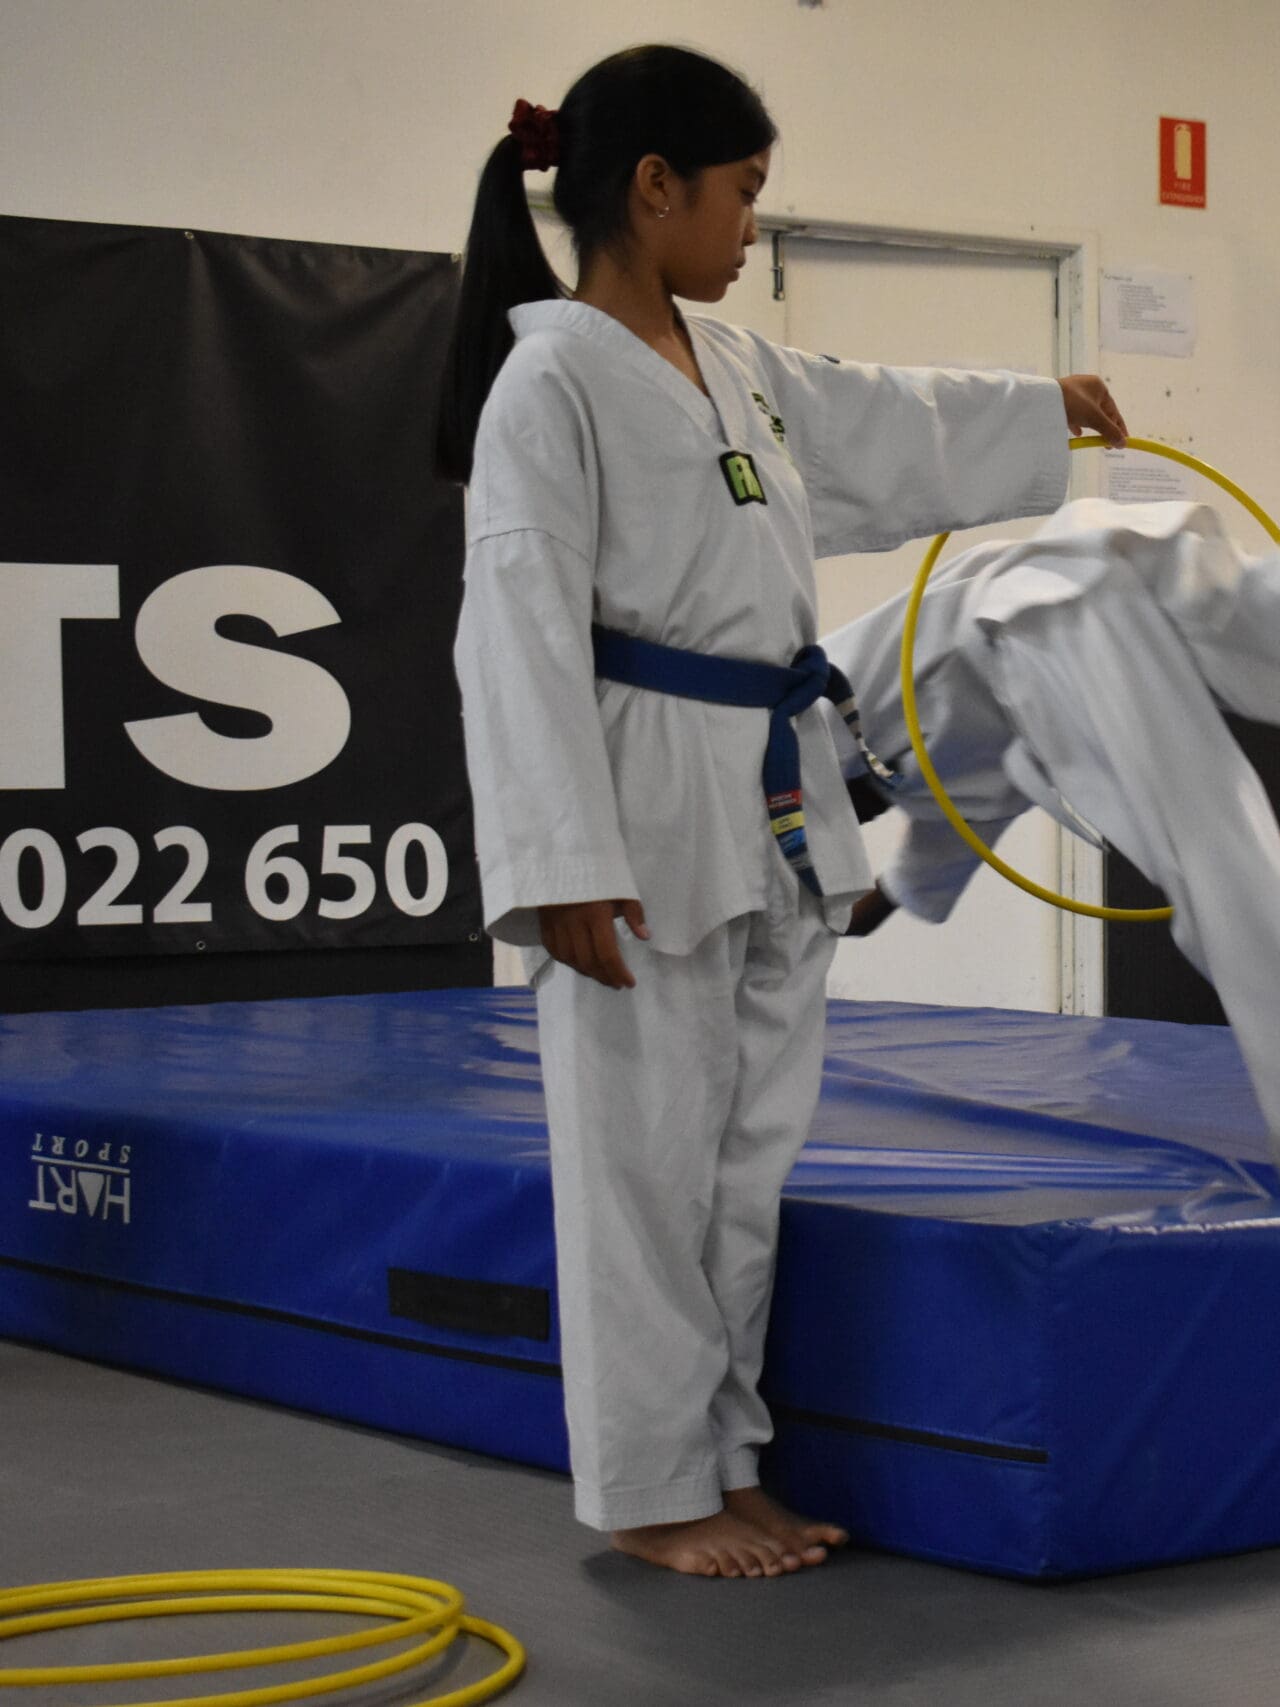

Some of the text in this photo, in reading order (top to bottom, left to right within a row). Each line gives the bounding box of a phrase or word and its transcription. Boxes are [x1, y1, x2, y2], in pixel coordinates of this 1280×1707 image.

[0, 562, 351, 791] TS
[0, 822, 449, 929] 022 650
[32, 1133, 131, 1164] SPORT
[28, 1164, 131, 1224] HART
